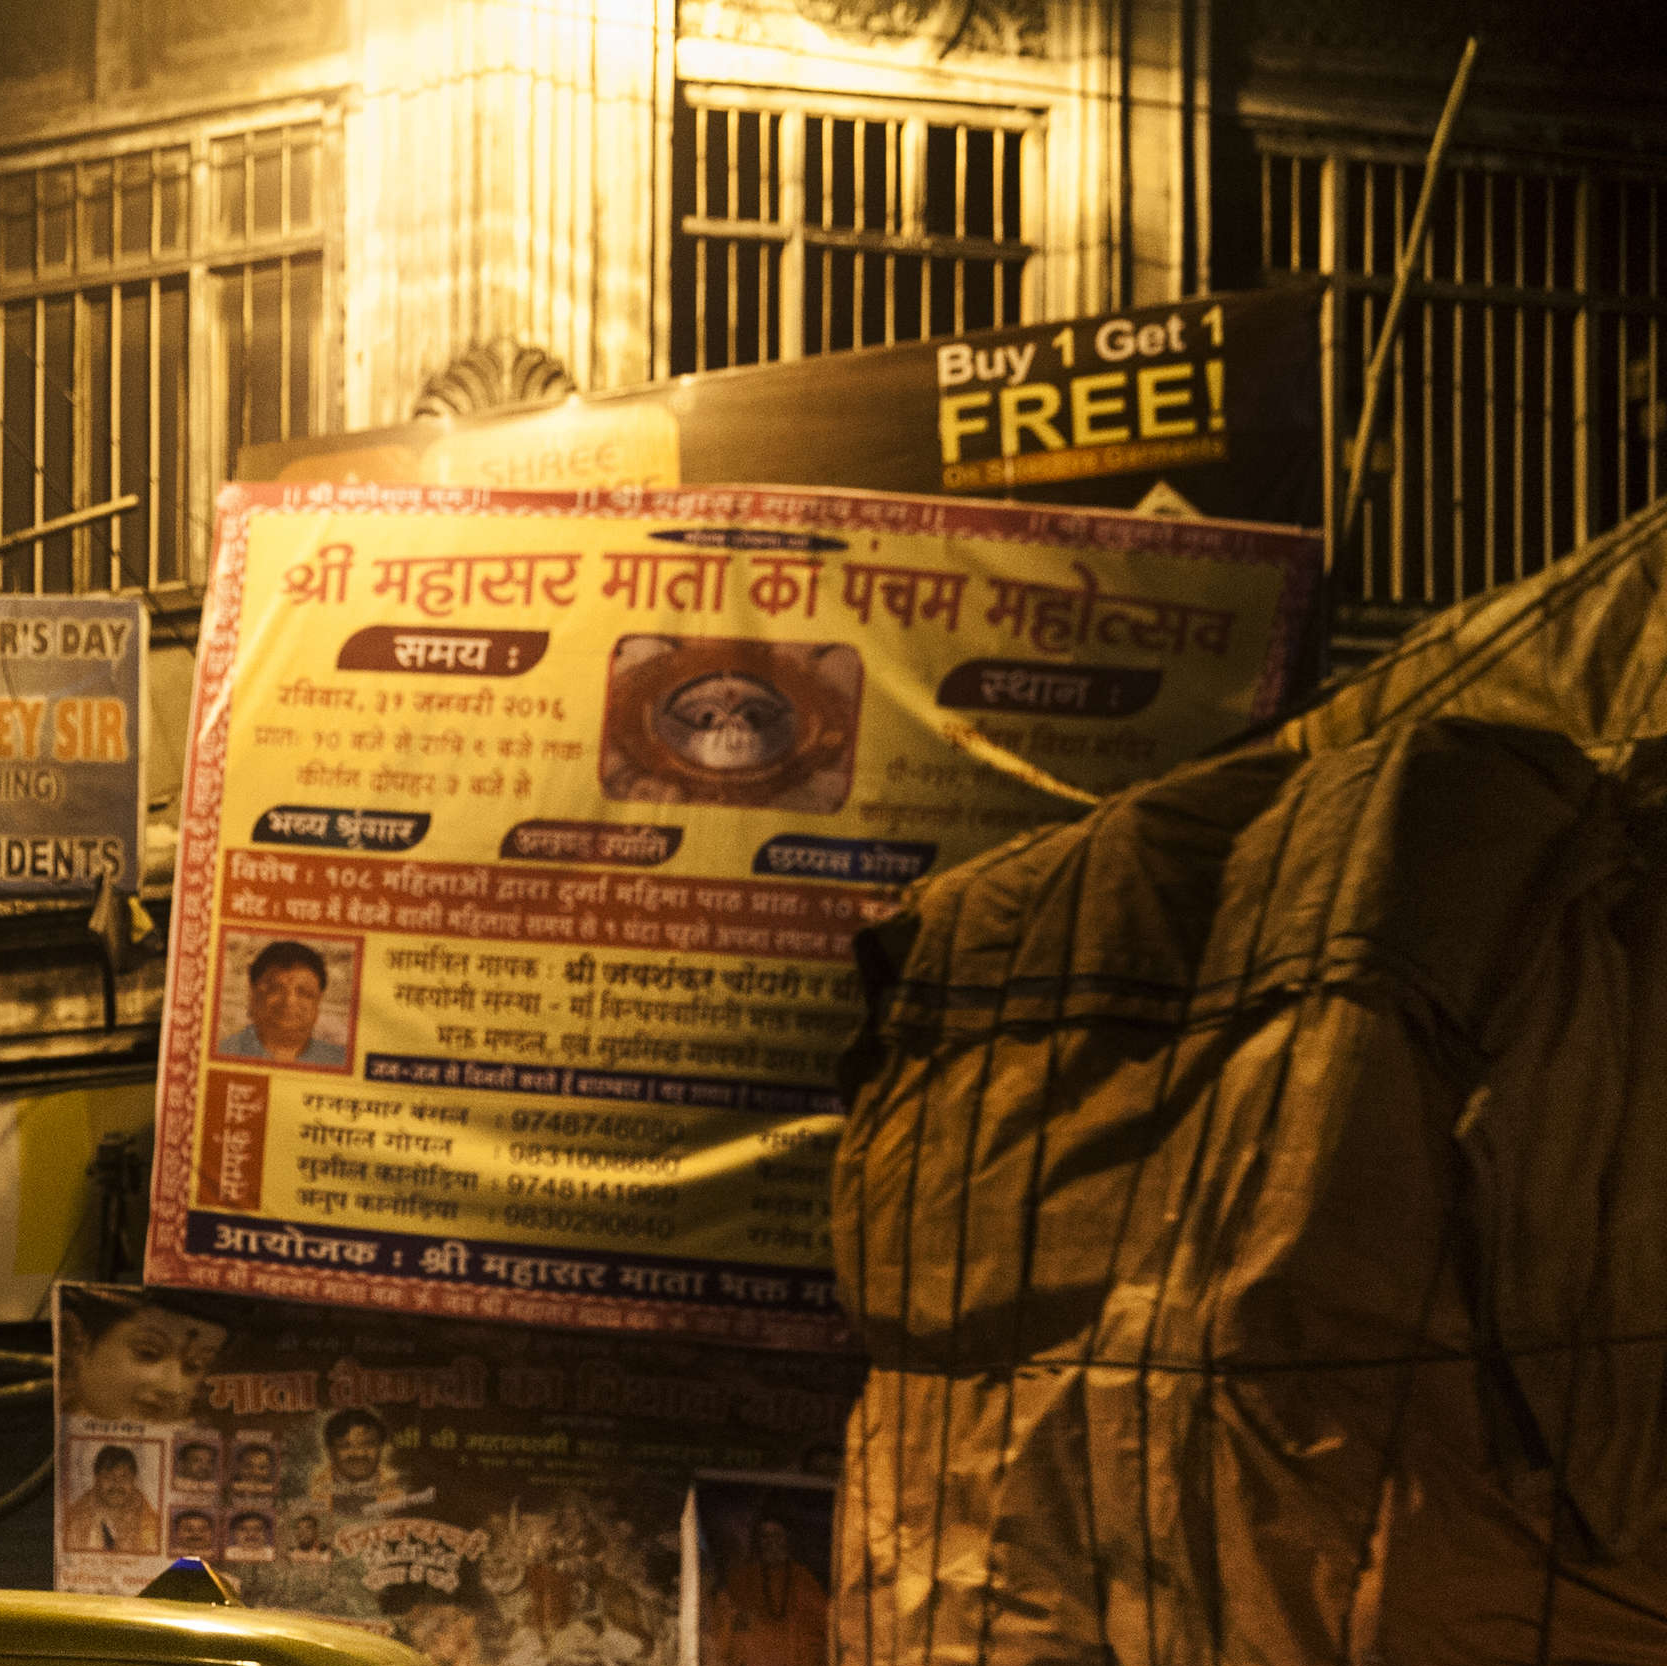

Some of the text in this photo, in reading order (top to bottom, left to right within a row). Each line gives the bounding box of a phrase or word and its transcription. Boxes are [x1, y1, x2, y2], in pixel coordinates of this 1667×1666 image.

[938, 305, 1225, 384] Buy 1 Get 1
[940, 358, 1227, 464] FREE!
[283, 543, 355, 606] श्री
[373, 554, 583, 618] महासर
[602, 552, 732, 612] माता
[842, 540, 970, 633] पंचम
[986, 562, 1238, 657] महोत्सव
[61, 618, 128, 655] DAY
[393, 634, 493, 670] समय
[980, 667, 1094, 708] स्थान
[54, 698, 127, 761] SIR
[266, 810, 329, 838] भव्य
[325, 864, 374, 890] १०८
[213, 1224, 380, 1266] आयोजक
[417, 1241, 469, 1277] श्री
[480, 1253, 610, 1289] महासर
[618, 1264, 709, 1297] माता
